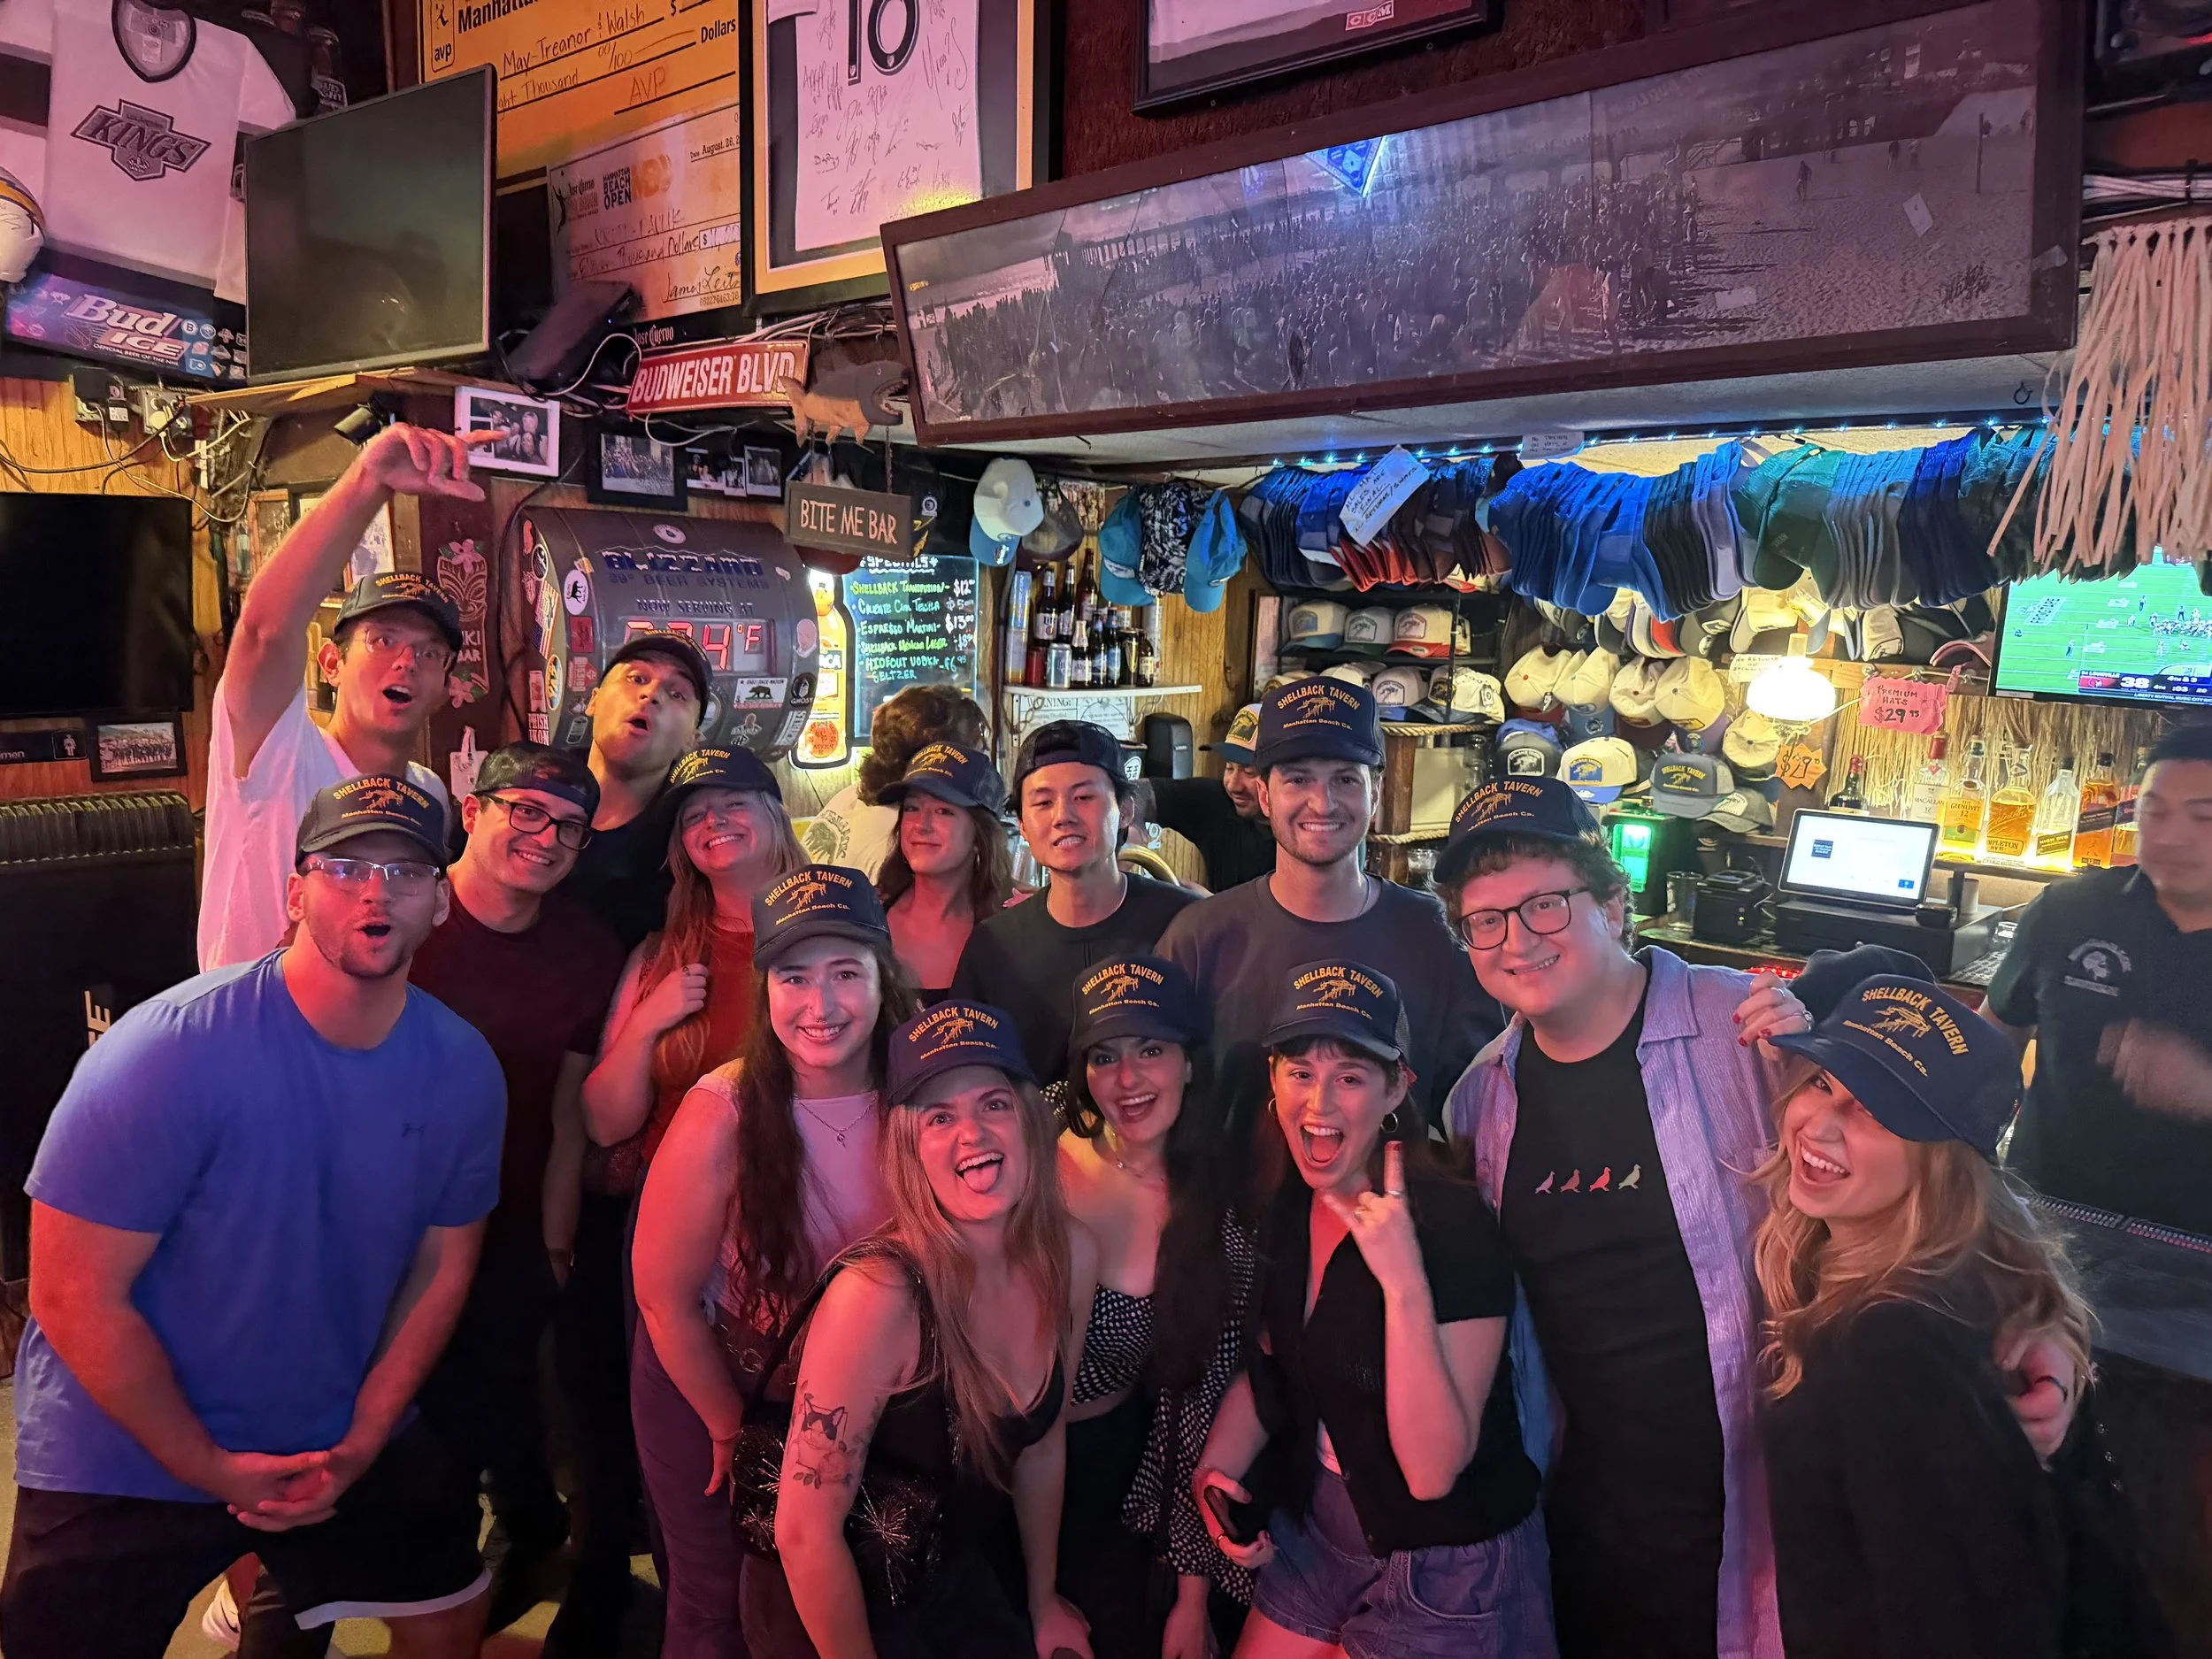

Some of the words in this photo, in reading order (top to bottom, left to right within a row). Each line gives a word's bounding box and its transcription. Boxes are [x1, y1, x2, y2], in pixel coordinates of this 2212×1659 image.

[606, 9, 645, 36] Walsh
[700, 18, 736, 43] Dollars
[434, 42, 452, 62] avp
[498, 92, 518, 120] ght
[522, 68, 579, 100] Thousand
[90, 114, 197, 164] KINGS
[603, 176, 630, 195] BEACH
[604, 188, 632, 210] OPEN
[65, 295, 177, 337] Bud
[110, 333, 184, 356] ICE
[649, 324, 675, 346] Cuervo
[94, 343, 123, 356] OFFICIAL
[125, 350, 141, 359] BEER
[631, 357, 733, 403] BUDWEISER
[737, 351, 795, 395] BLVD
[1351, 489, 1369, 513] SALES
[1373, 469, 1386, 484] ARE
[801, 499, 836, 533] BITE
[841, 505, 864, 537] ME
[868, 510, 897, 544] BAR
[602, 550, 764, 576] BLIZZARD
[375, 573, 421, 588] SHELLBACK
[426, 579, 449, 603] TAVERN
[852, 580, 898, 595] SHELLBACK
[636, 598, 670, 613] NOW
[678, 600, 733, 615] SERVING
[739, 602, 753, 615] AT
[860, 619, 902, 636] ESPRESSO
[461, 630, 481, 646] IKI
[865, 656, 908, 672] HIDEOUT
[910, 656, 940, 668] VODKA
[872, 669, 918, 683] SELTZER
[2120, 677, 2150, 689] 38
[1277, 685, 1325, 710] SHELLBACK
[1329, 686, 1361, 710] TAVERN
[1877, 685, 1918, 698] PREMIUM
[1882, 696, 1909, 706] HATS
[1283, 718, 1317, 729] Manhattan
[0, 750, 25, 760] men
[944, 746, 969, 765] TAVERN
[670, 749, 698, 785] SHELLBACK
[701, 749, 731, 759] TAVERN
[1687, 767, 1706, 780] TAVERN
[333, 778, 391, 800] SHELLBACK
[396, 781, 430, 810] TAVERN
[1455, 782, 1498, 823] SHELLBACK
[1503, 780, 1544, 797] TAVERN
[1915, 797, 1945, 806] MACALLAN
[342, 809, 383, 818] Manhattan
[1950, 803, 1981, 812] GLENLIVET
[1960, 810, 1969, 818] 12
[764, 871, 812, 907] SHELLBACK
[817, 871, 854, 888] TAVERN
[775, 907, 810, 926] Manhattan
[1081, 964, 1125, 995] SHELLBACK
[1130, 964, 1164, 986] TAVERN
[1293, 966, 1347, 990] SHELLBACK
[1350, 969, 1385, 998] TAVERN
[1088, 1000, 1122, 1015] Manhattan
[1296, 1002, 1334, 1010] Manhattan
[1335, 1002, 1360, 1013] Beach
[909, 1007, 958, 1042] SHELLBACK
[964, 1007, 999, 1029] TAVERN
[1862, 987, 1932, 1011] SHELLBACK
[1929, 1006, 1970, 1056] TAVERN
[920, 1042, 958, 1060] Manhattan
[1884, 1037, 1914, 1062] Beach
